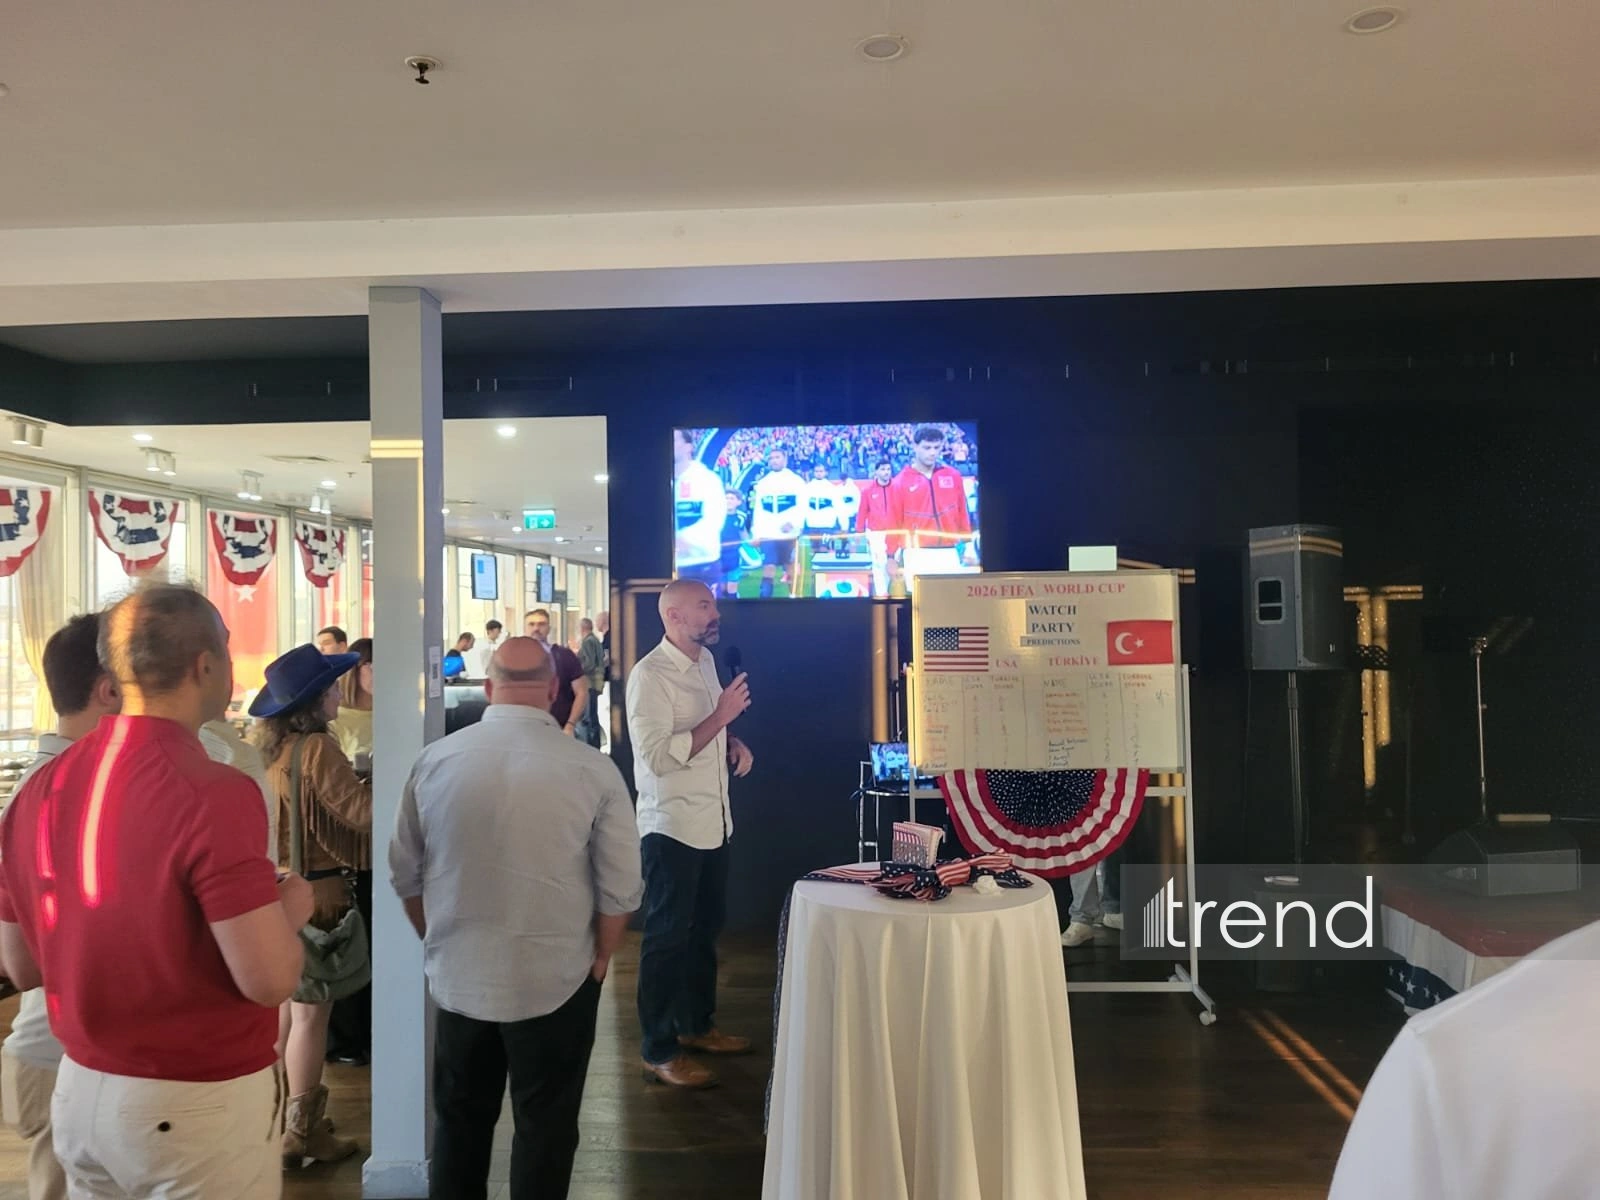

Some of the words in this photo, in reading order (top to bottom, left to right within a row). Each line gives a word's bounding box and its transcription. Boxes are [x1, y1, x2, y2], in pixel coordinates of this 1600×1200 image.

[967, 585, 997, 597] 2026
[1001, 584, 1035, 597] FIFA
[1043, 583, 1095, 594] WORLD
[1098, 583, 1126, 594] CUP
[1028, 604, 1077, 616] WATCH
[1031, 622, 1074, 633] PARTY
[1026, 638, 1081, 646] PREDICTIONS
[995, 658, 1018, 669] USA
